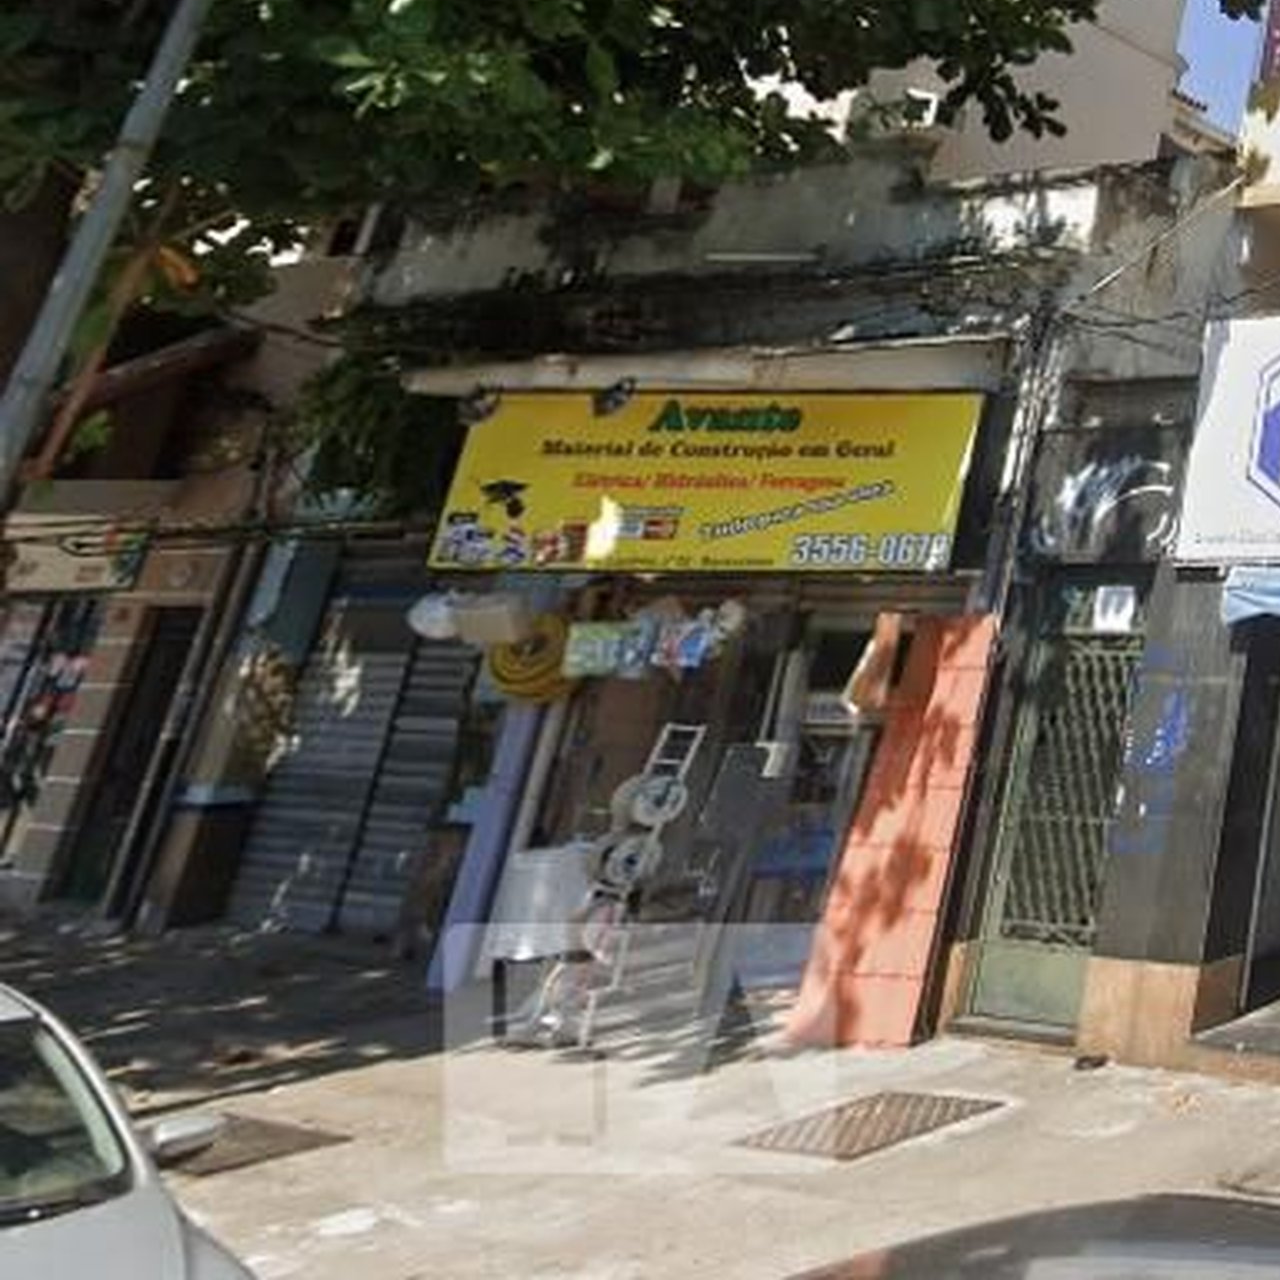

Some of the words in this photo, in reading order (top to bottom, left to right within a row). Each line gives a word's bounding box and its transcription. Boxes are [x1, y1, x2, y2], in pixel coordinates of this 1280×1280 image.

[542, 439, 634, 457] Material
[637, 439, 663, 458] de
[670, 440, 792, 461] Construção
